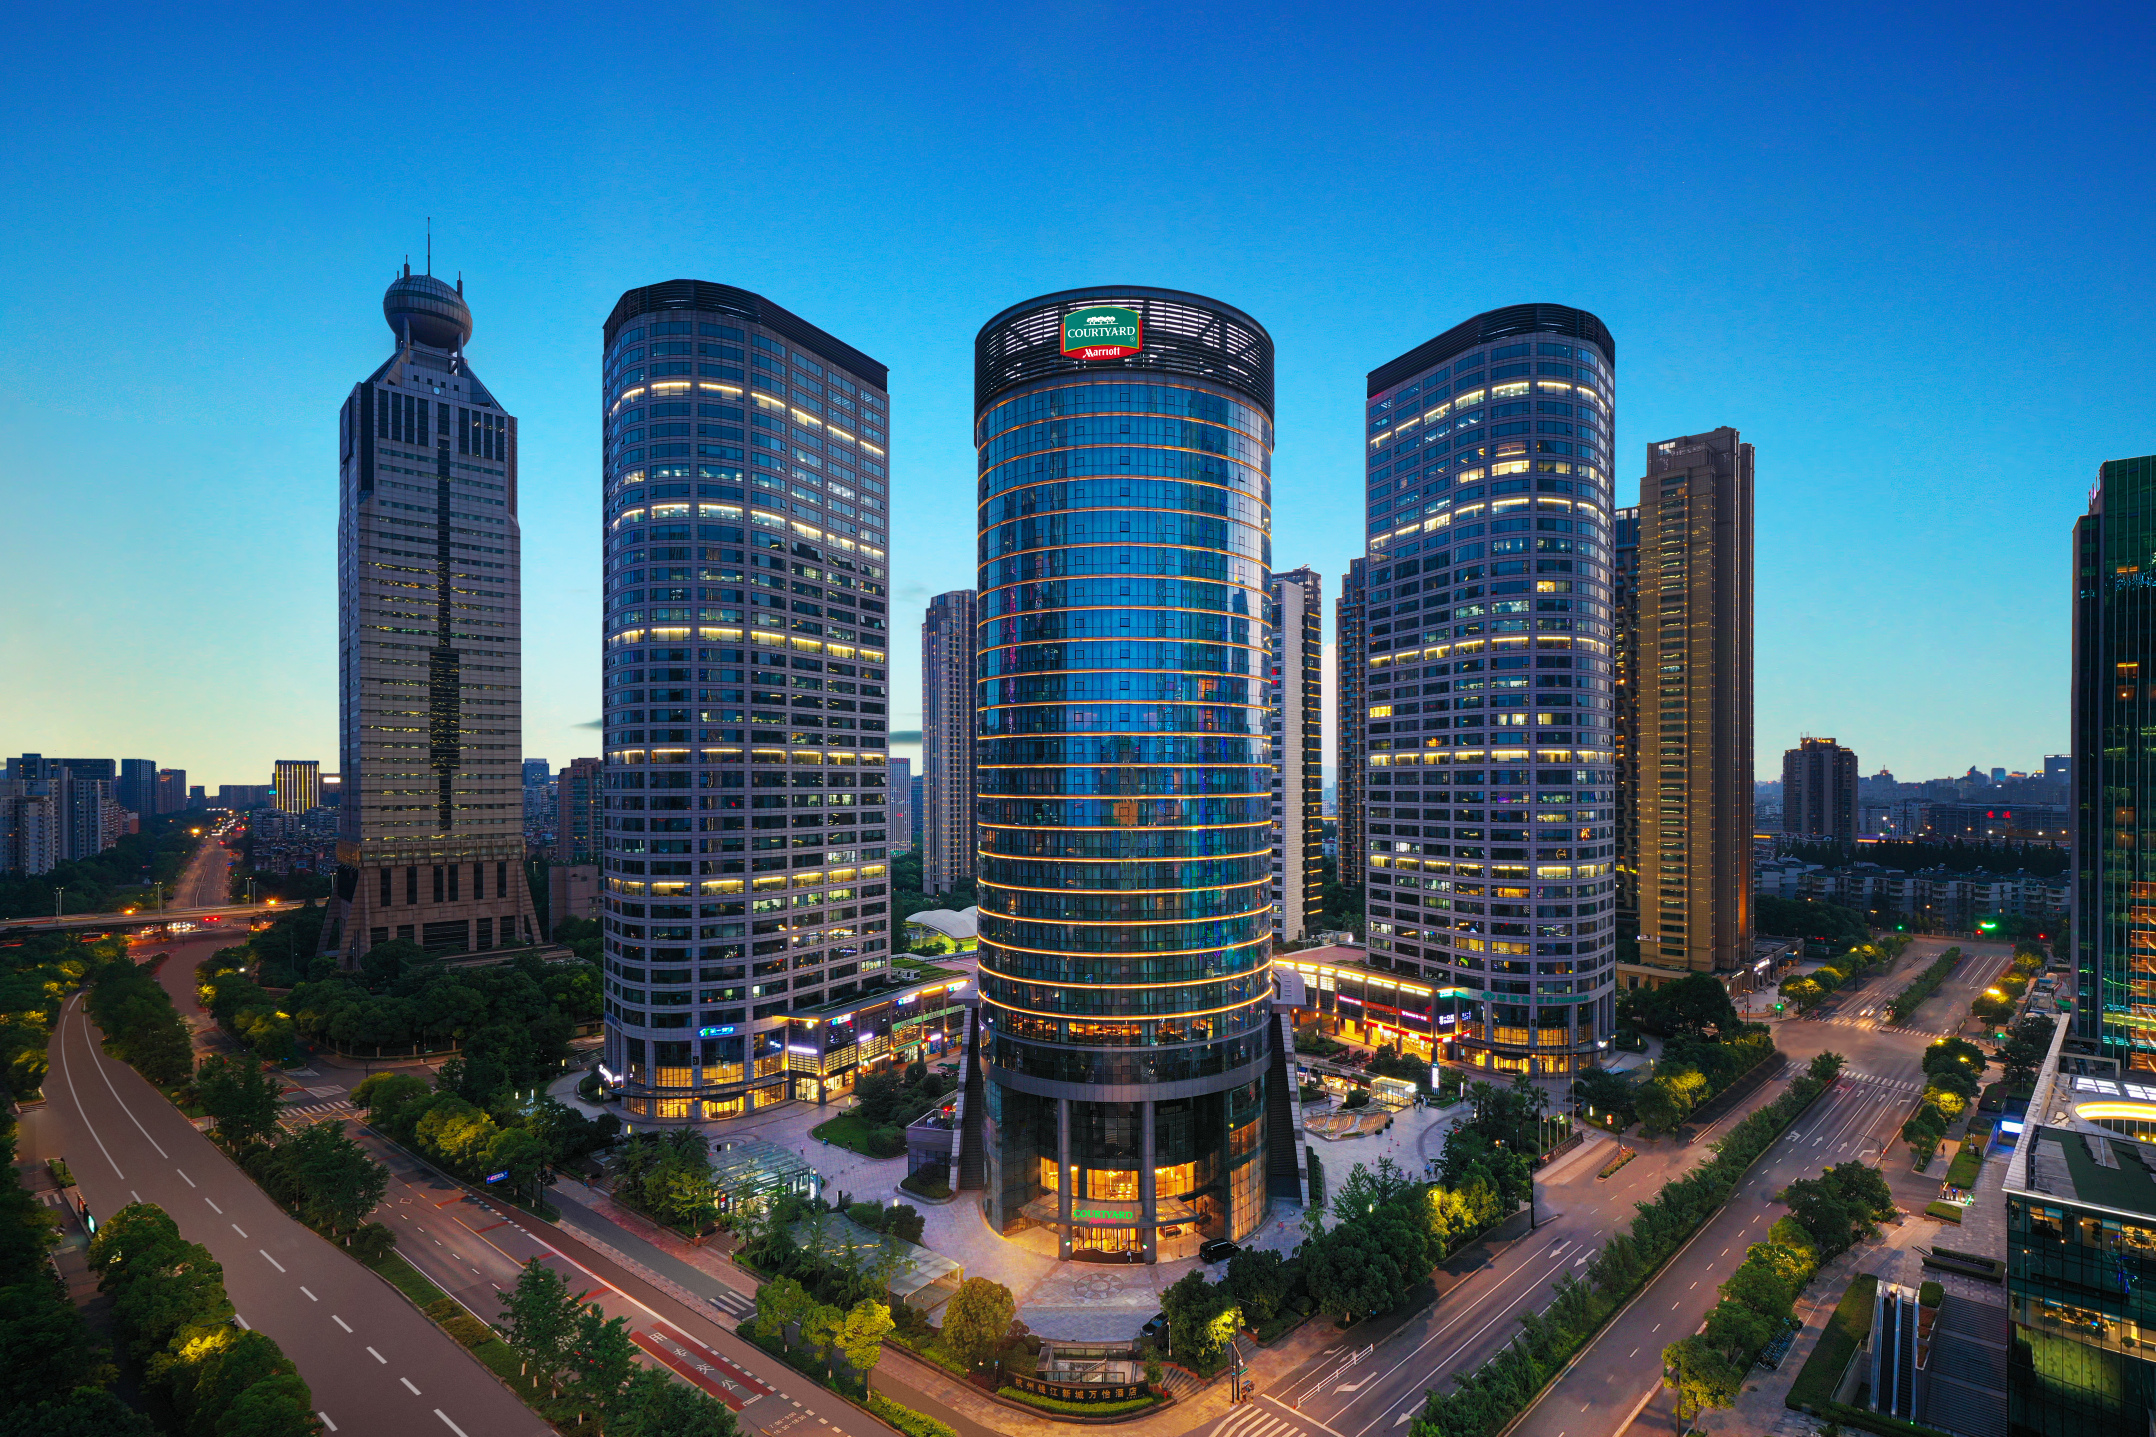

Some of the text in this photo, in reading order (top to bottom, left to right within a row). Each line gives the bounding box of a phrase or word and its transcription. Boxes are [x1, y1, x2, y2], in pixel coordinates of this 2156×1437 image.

[1067, 326, 1136, 338] COURTYARD
[1082, 347, 1120, 358] Marriott
[1073, 1209, 1133, 1220] COURTYARD
[1015, 1377, 1138, 1400] 杭州钱江新城万怡酒店
